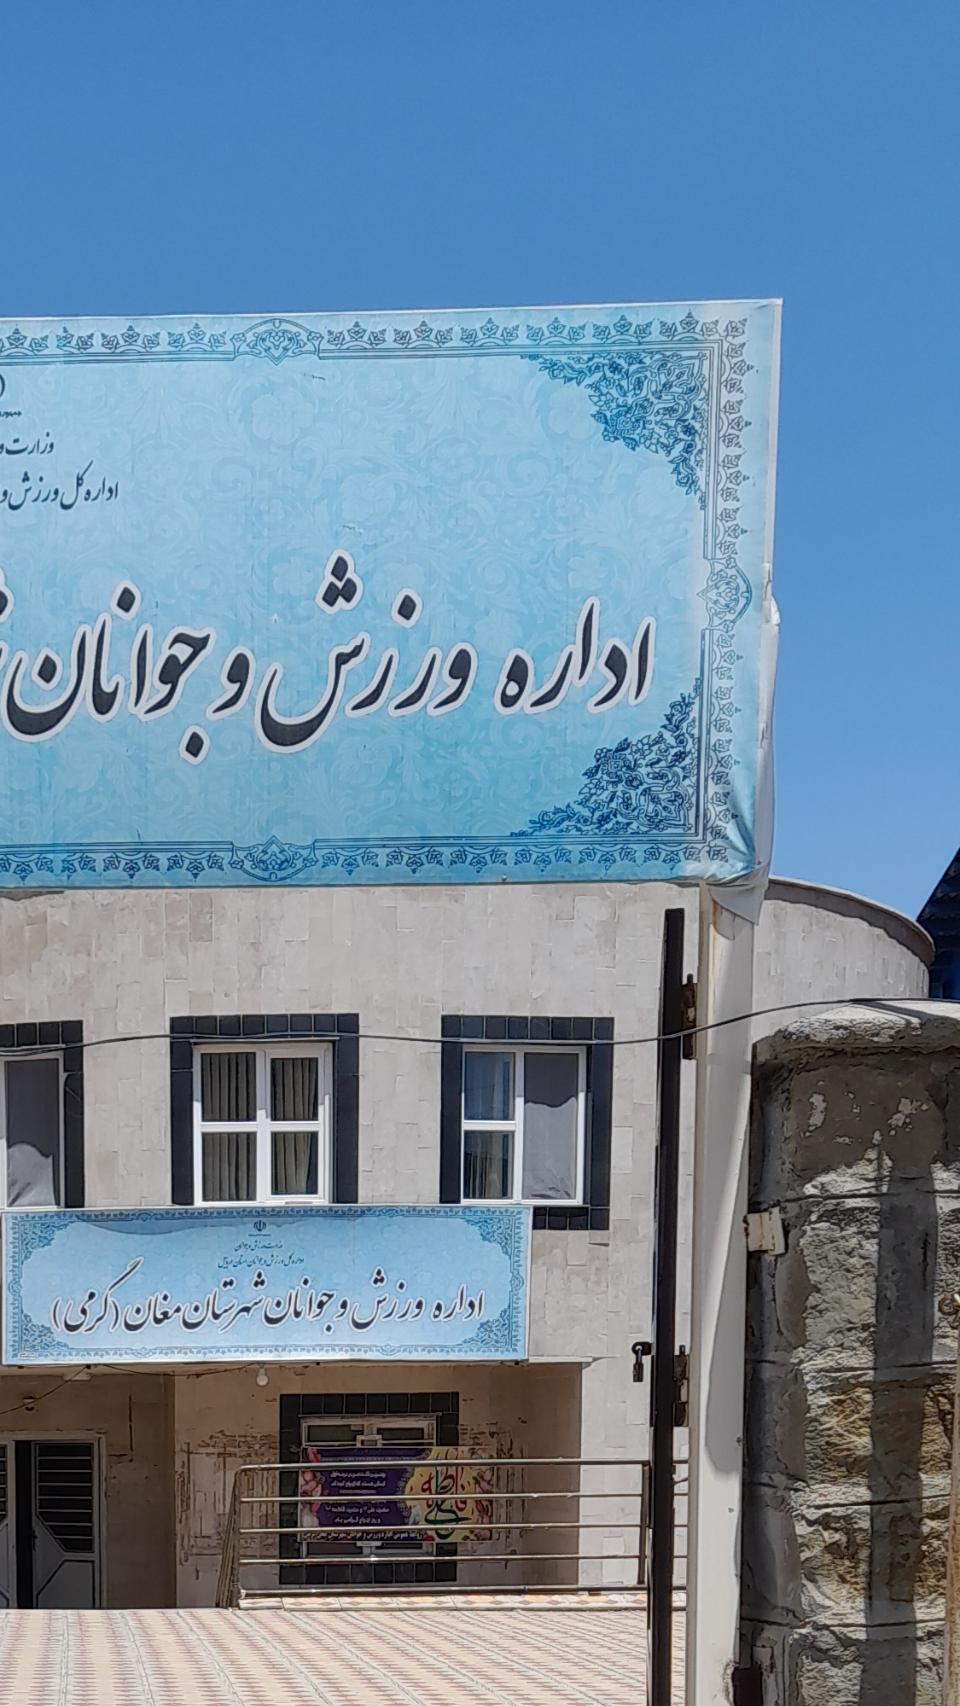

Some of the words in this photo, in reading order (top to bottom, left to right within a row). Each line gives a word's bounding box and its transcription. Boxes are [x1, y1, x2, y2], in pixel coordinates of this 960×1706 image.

[5, 431, 55, 456] وزارت
[7, 470, 60, 511] ورزش
[59, 459, 94, 511] کل
[83, 476, 120, 503] اداره
[5, 585, 213, 759] جوانان
[259, 554, 473, 748] ورزش
[498, 600, 652, 709] اداره
[211, 651, 251, 715] و
[123, 1292, 182, 1332] مغان
[181, 1270, 266, 1333] شهرستان
[263, 1276, 335, 1333] جوانان
[350, 1267, 424, 1330] ورزش
[431, 1284, 485, 1320] اداره
